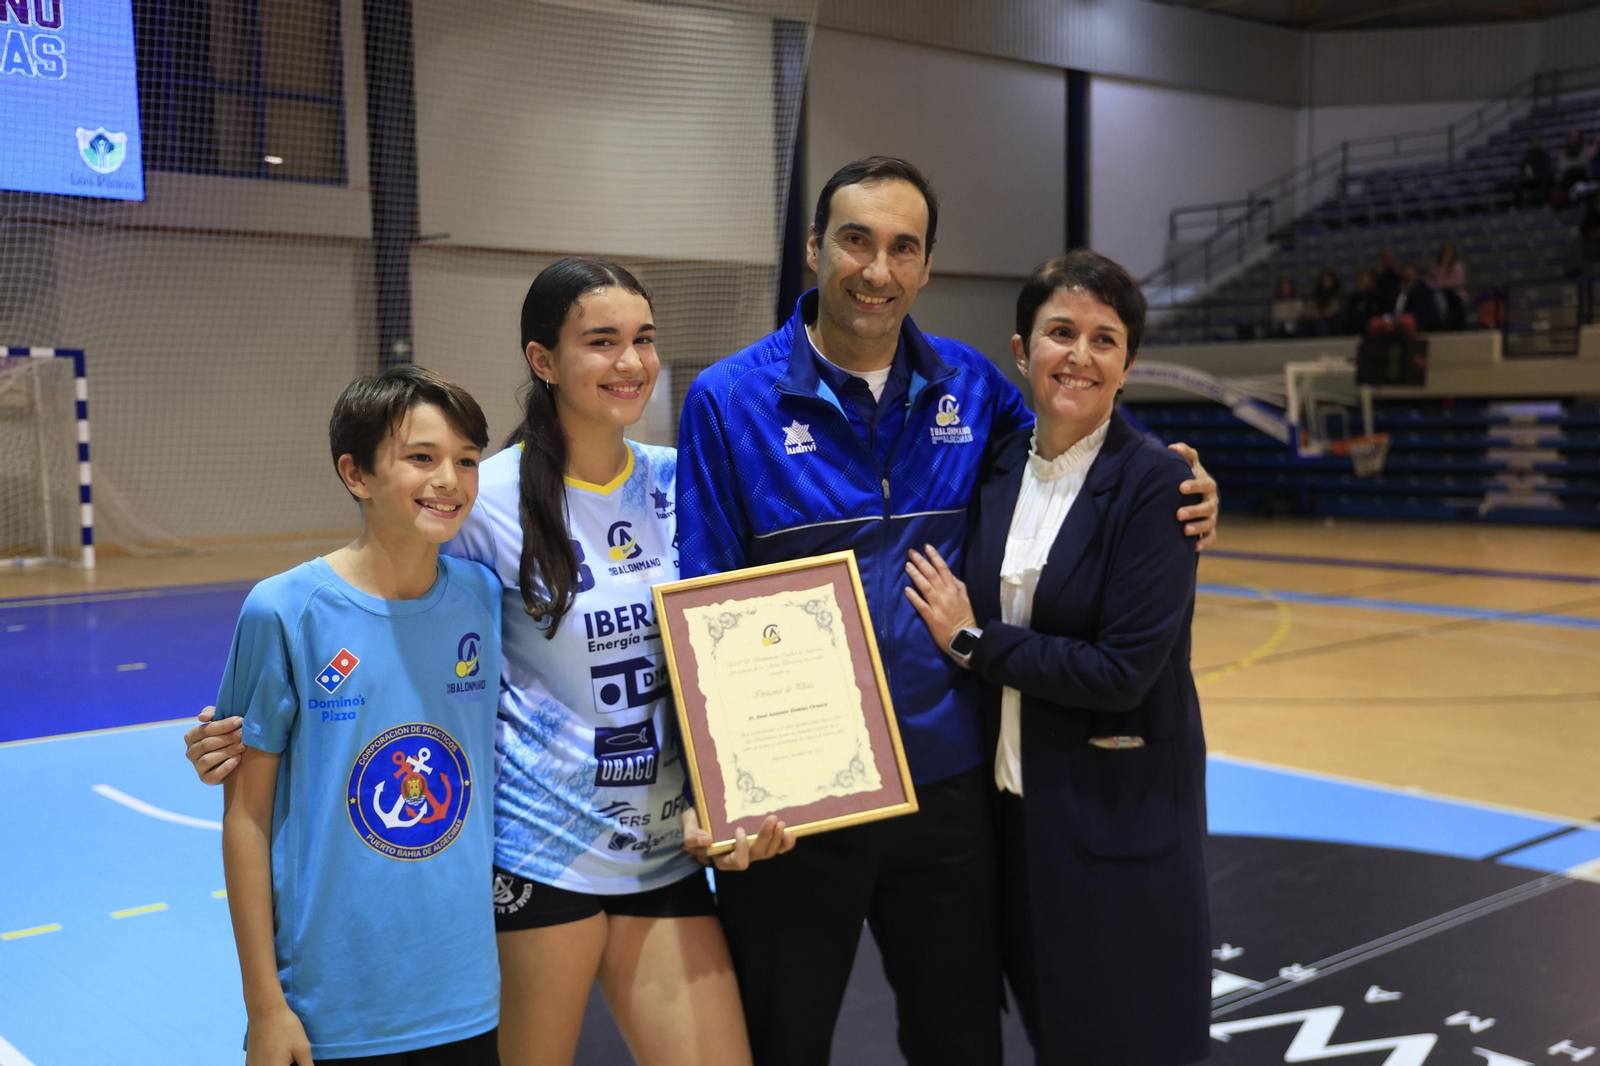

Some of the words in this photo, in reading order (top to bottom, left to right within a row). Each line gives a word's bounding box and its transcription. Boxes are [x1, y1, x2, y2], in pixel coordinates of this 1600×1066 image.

[612, 557, 661, 576] BALONMANO
[587, 633, 640, 653] Energía
[450, 679, 486, 693] BALONMANO
[308, 694, 366, 710] Domino's
[322, 710, 356, 722] Pizza
[358, 727, 410, 766] CORPORACION
[410, 725, 421, 733] DE
[422, 726, 458, 753] PRACTICOS
[366, 833, 396, 855] PUERTO
[396, 849, 421, 858] BAHIA
[422, 848, 432, 857] DE
[433, 818, 463, 853] ALGECIRAS
